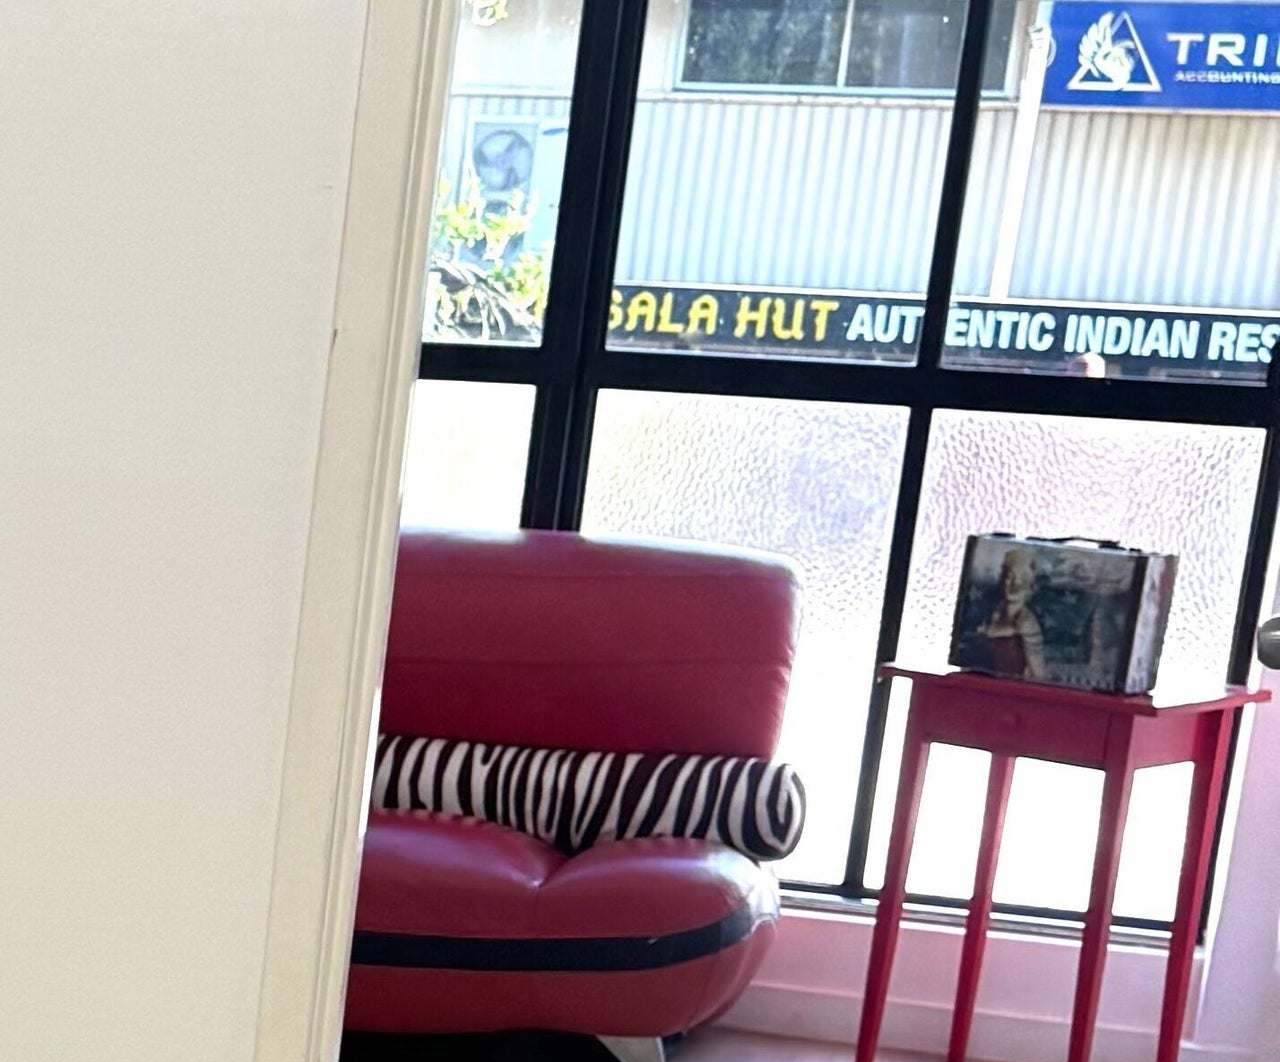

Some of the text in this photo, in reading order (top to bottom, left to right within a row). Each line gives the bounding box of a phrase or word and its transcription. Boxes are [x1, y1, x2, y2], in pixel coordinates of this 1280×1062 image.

[1166, 32, 1280, 67] TRI
[734, 296, 839, 342] HUT
[1063, 313, 1200, 360] INDIAN
